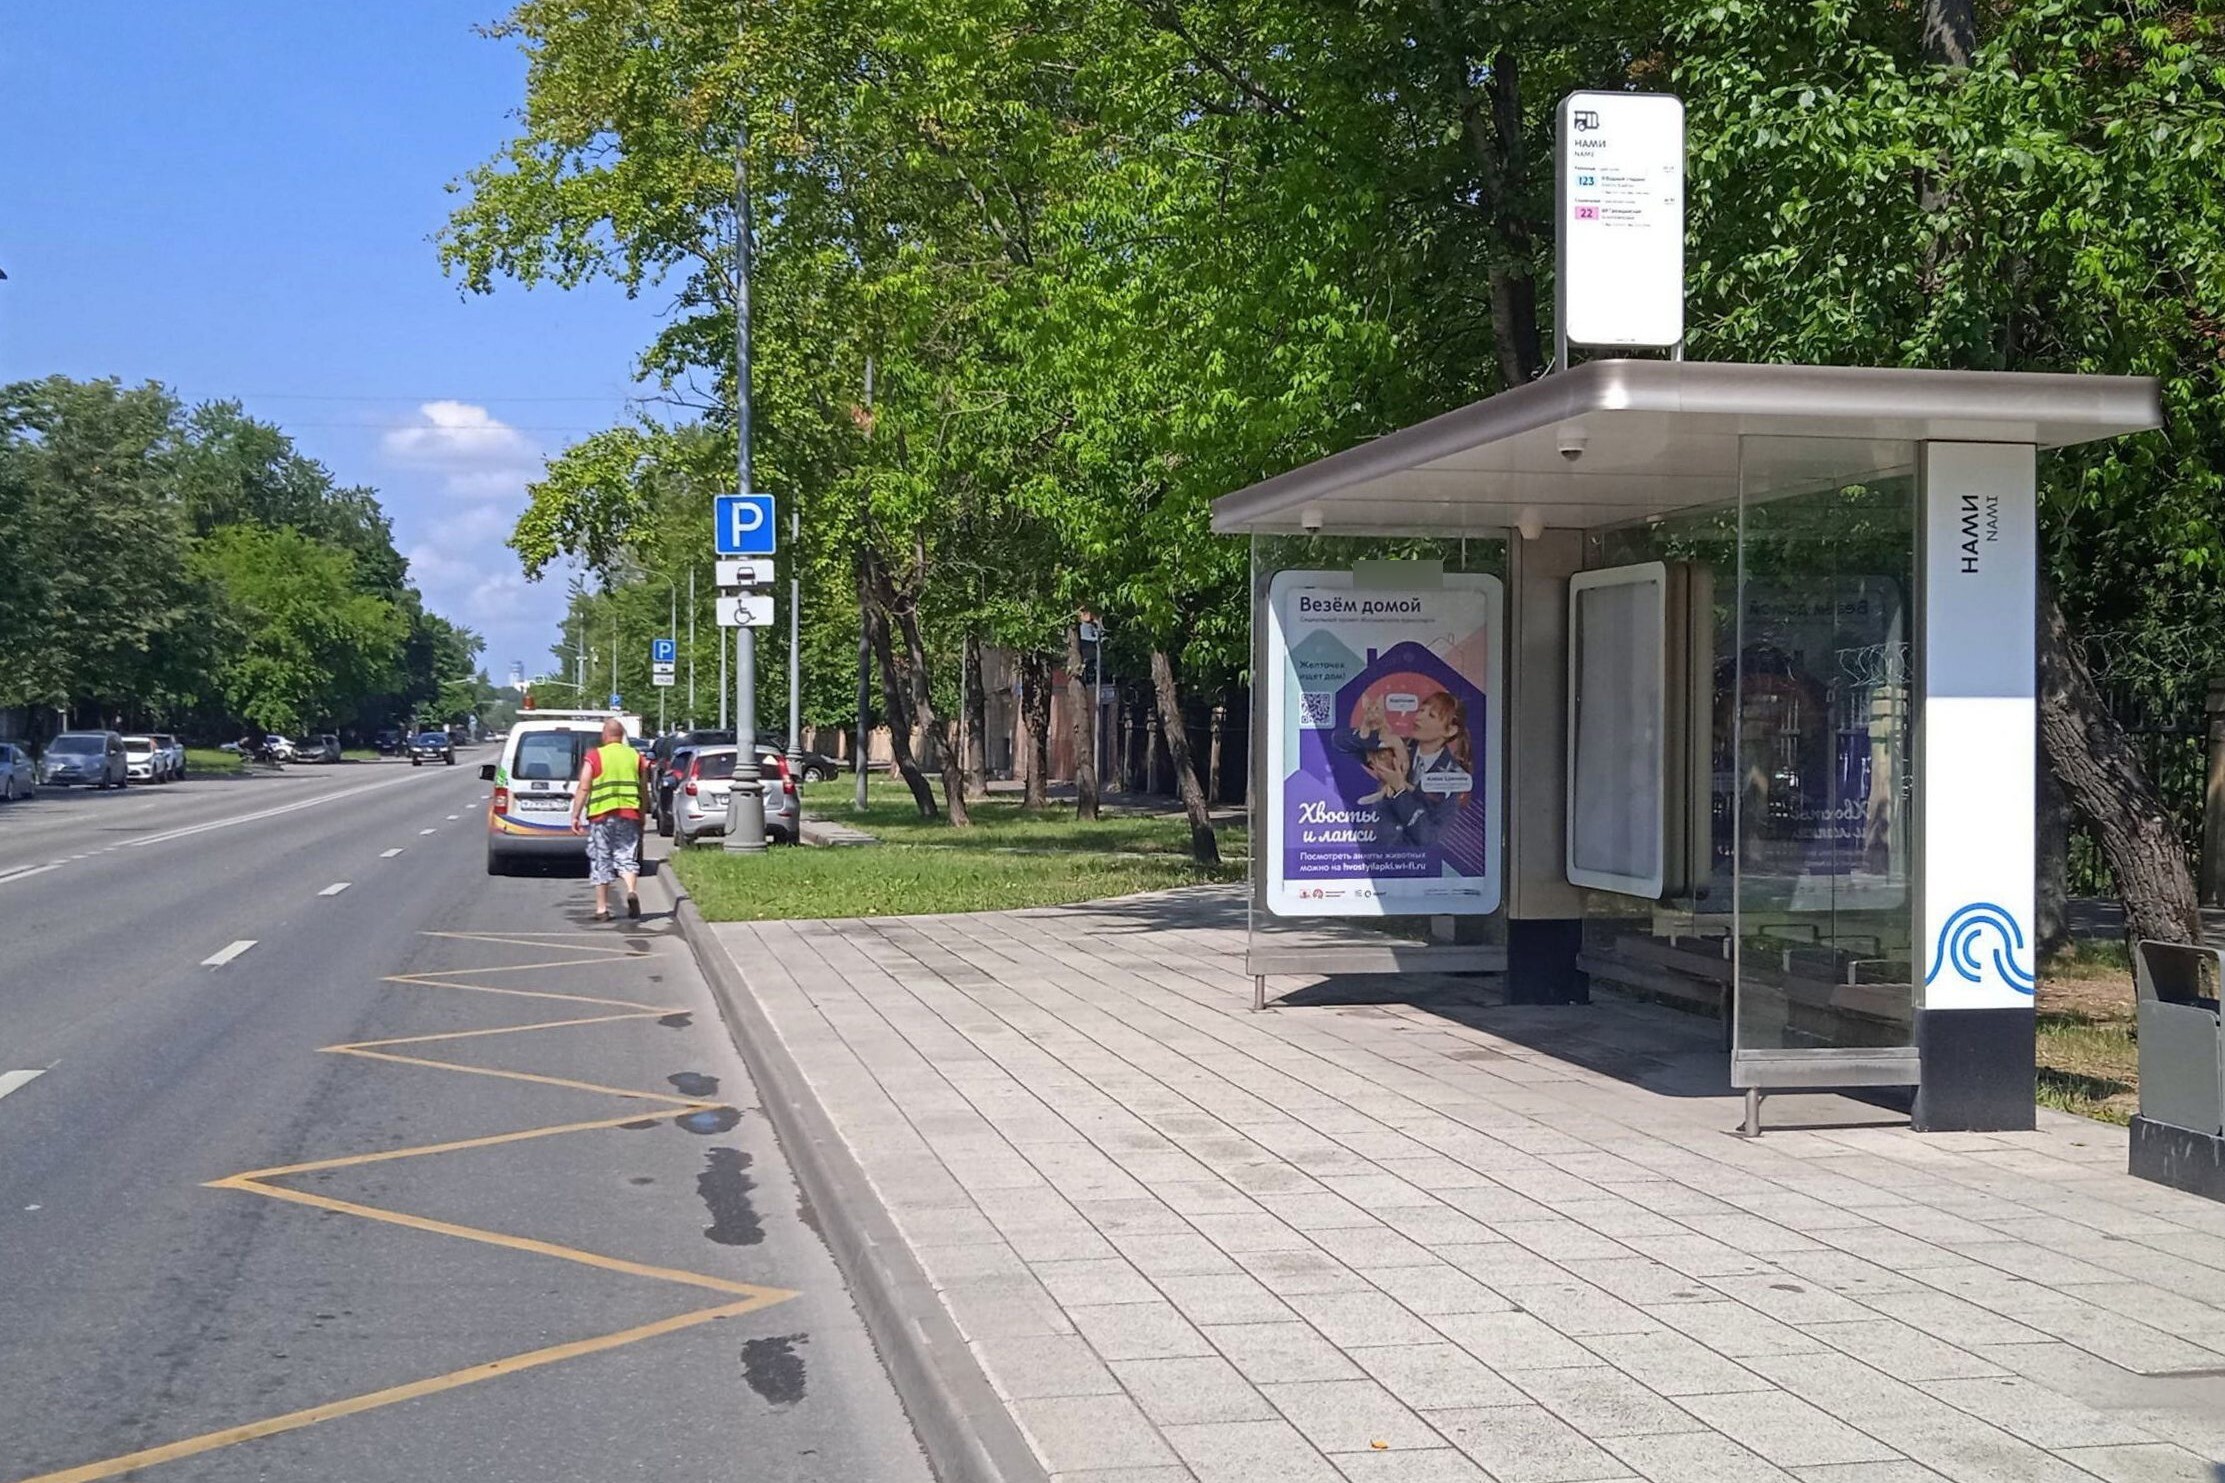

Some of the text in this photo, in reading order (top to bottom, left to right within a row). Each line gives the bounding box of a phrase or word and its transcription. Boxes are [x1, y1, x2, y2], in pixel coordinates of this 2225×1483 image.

[1574, 139, 1607, 148] НАМИ
[1579, 176, 1595, 186] 123
[1580, 208, 1593, 219] 22
[732, 502, 764, 548] P
[1986, 495, 1998, 542] NAMI
[1961, 495, 1979, 574] НАМИ
[1300, 596, 1422, 615] Везём домой
[1298, 800, 1381, 824] Хвосты
[1302, 829, 1378, 843] и лапки
[1299, 852, 1352, 862] Посмотреть
[1299, 863, 1330, 872] можно
[1331, 864, 1342, 872] на
